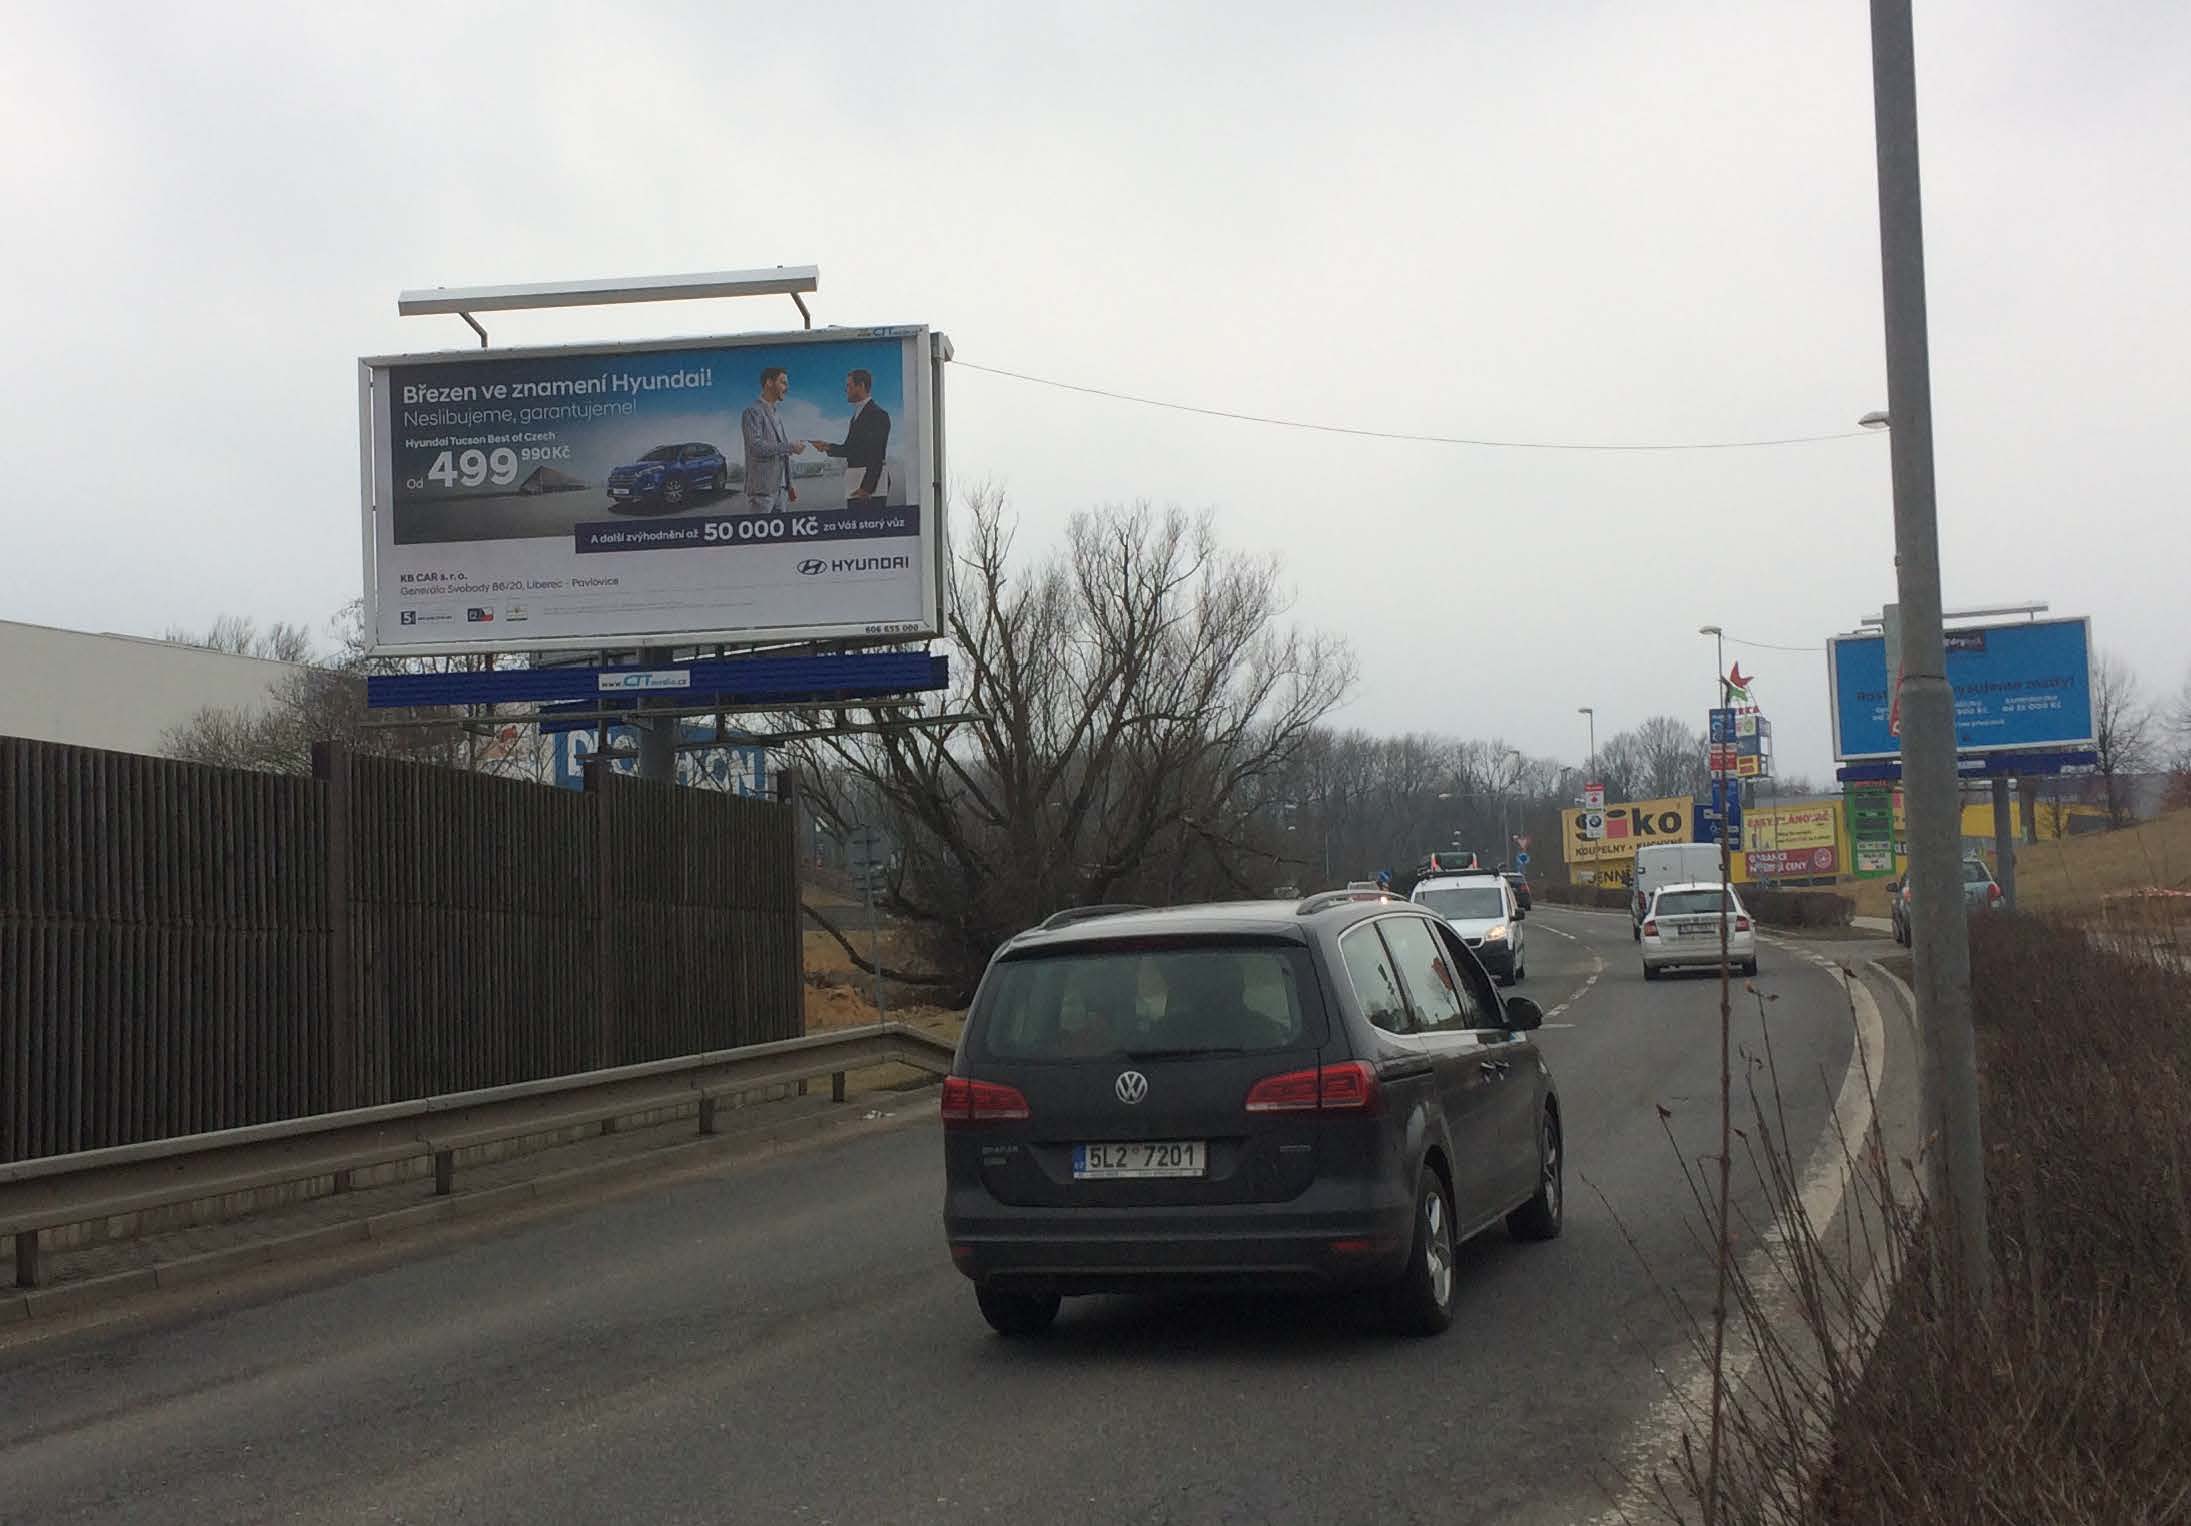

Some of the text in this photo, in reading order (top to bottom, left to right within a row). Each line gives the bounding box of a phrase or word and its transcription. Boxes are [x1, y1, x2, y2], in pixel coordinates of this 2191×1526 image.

[403, 368, 713, 404] Březen ve znamení Hyundai!
[404, 399, 637, 428] Neslibujeme, garantujeme!
[405, 437, 449, 449] Hyundai
[450, 435, 487, 446] Tucson
[488, 434, 510, 444] Best
[512, 433, 523, 443] of
[407, 445, 571, 490] Od 499 990 Kč
[591, 515, 905, 544] A další zvýhodnění až 50 000 Kč za Váš starý vůz
[832, 556, 909, 573] HYUNDAI
[400, 574, 415, 583] KB
[416, 573, 438, 582] CAR
[448, 582, 491, 594] Svobody
[526, 578, 563, 590] Liberec
[572, 577, 619, 589] Pavlovice
[902, 623, 919, 632] 000
[1090, 1146, 1127, 1168] 5L2
[1144, 1144, 1194, 1168] 7201
